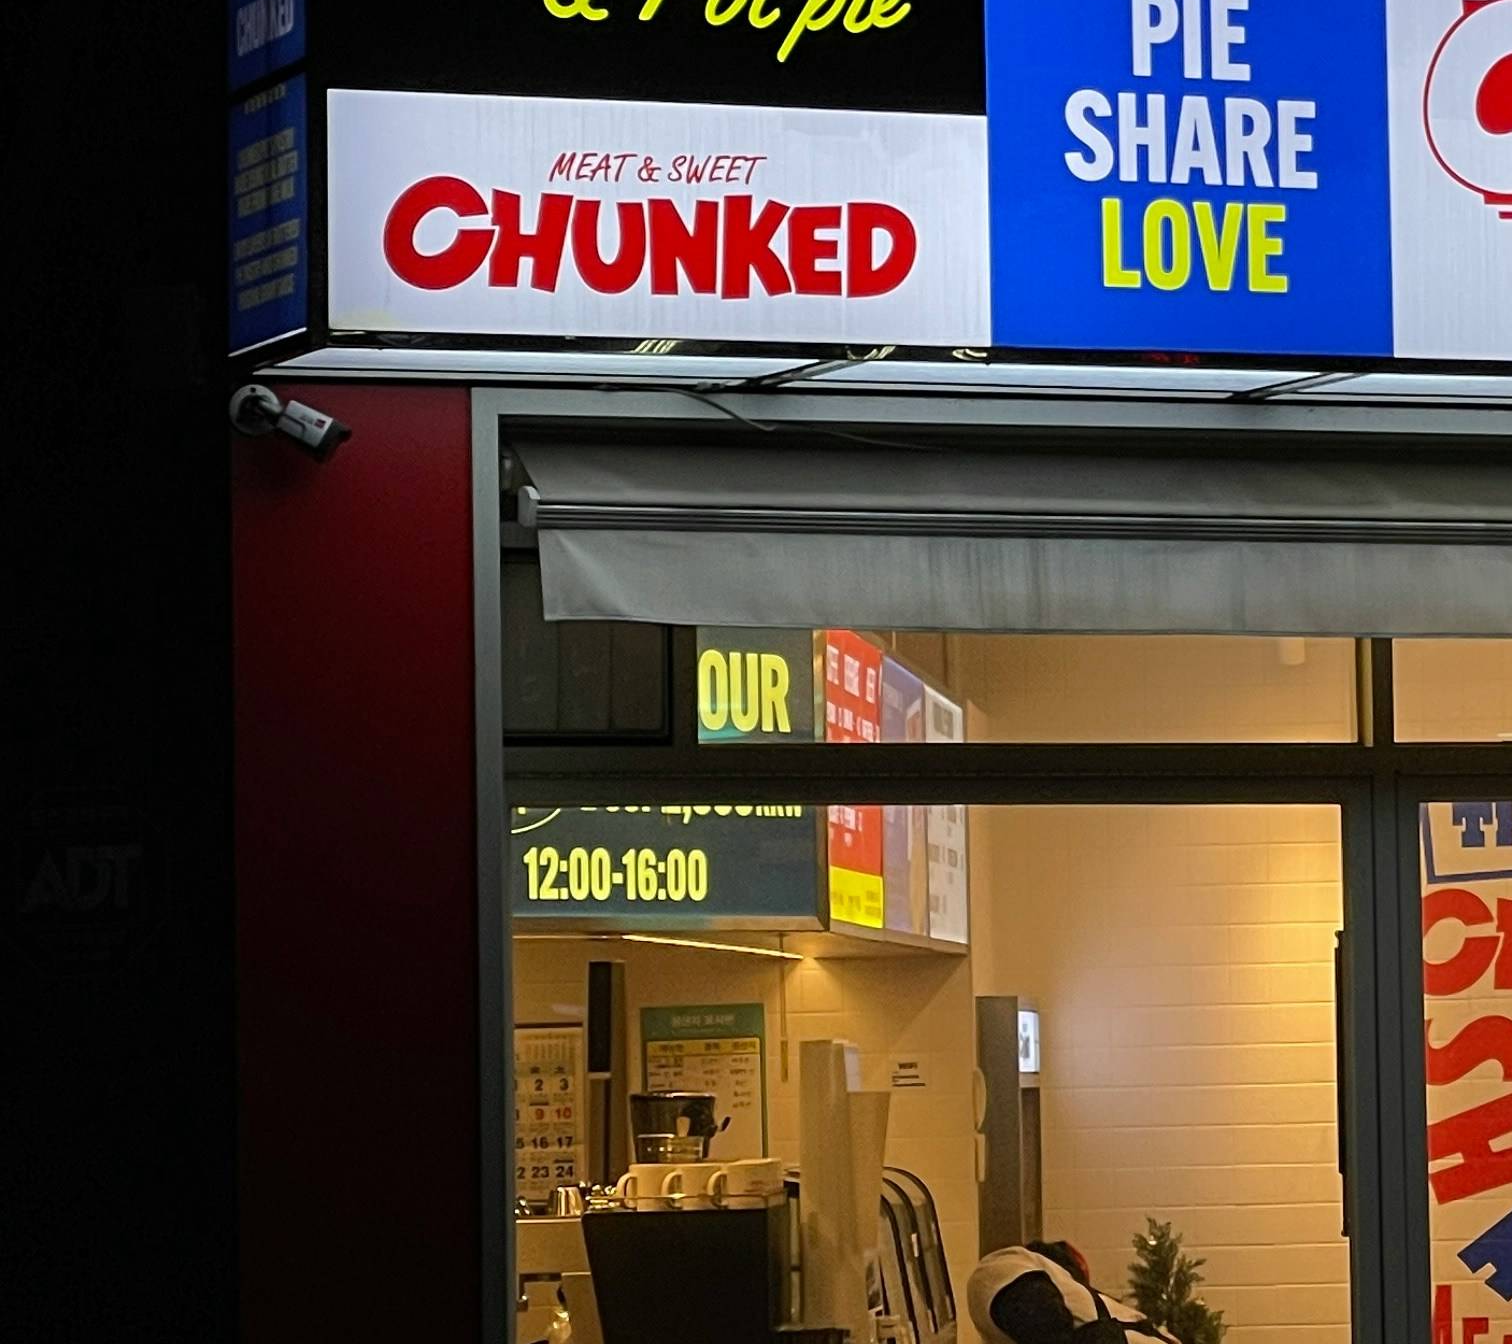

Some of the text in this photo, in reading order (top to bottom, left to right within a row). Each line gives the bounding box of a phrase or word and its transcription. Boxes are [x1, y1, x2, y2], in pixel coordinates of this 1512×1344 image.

[548, 153, 767, 185] MEAT & SWEET
[1064, 90, 1318, 189] SHARE
[383, 175, 917, 300] CHUNKED
[1101, 198, 1288, 293] LOVE
[699, 649, 792, 733] OUR
[523, 847, 708, 901] 12:00-16:00
